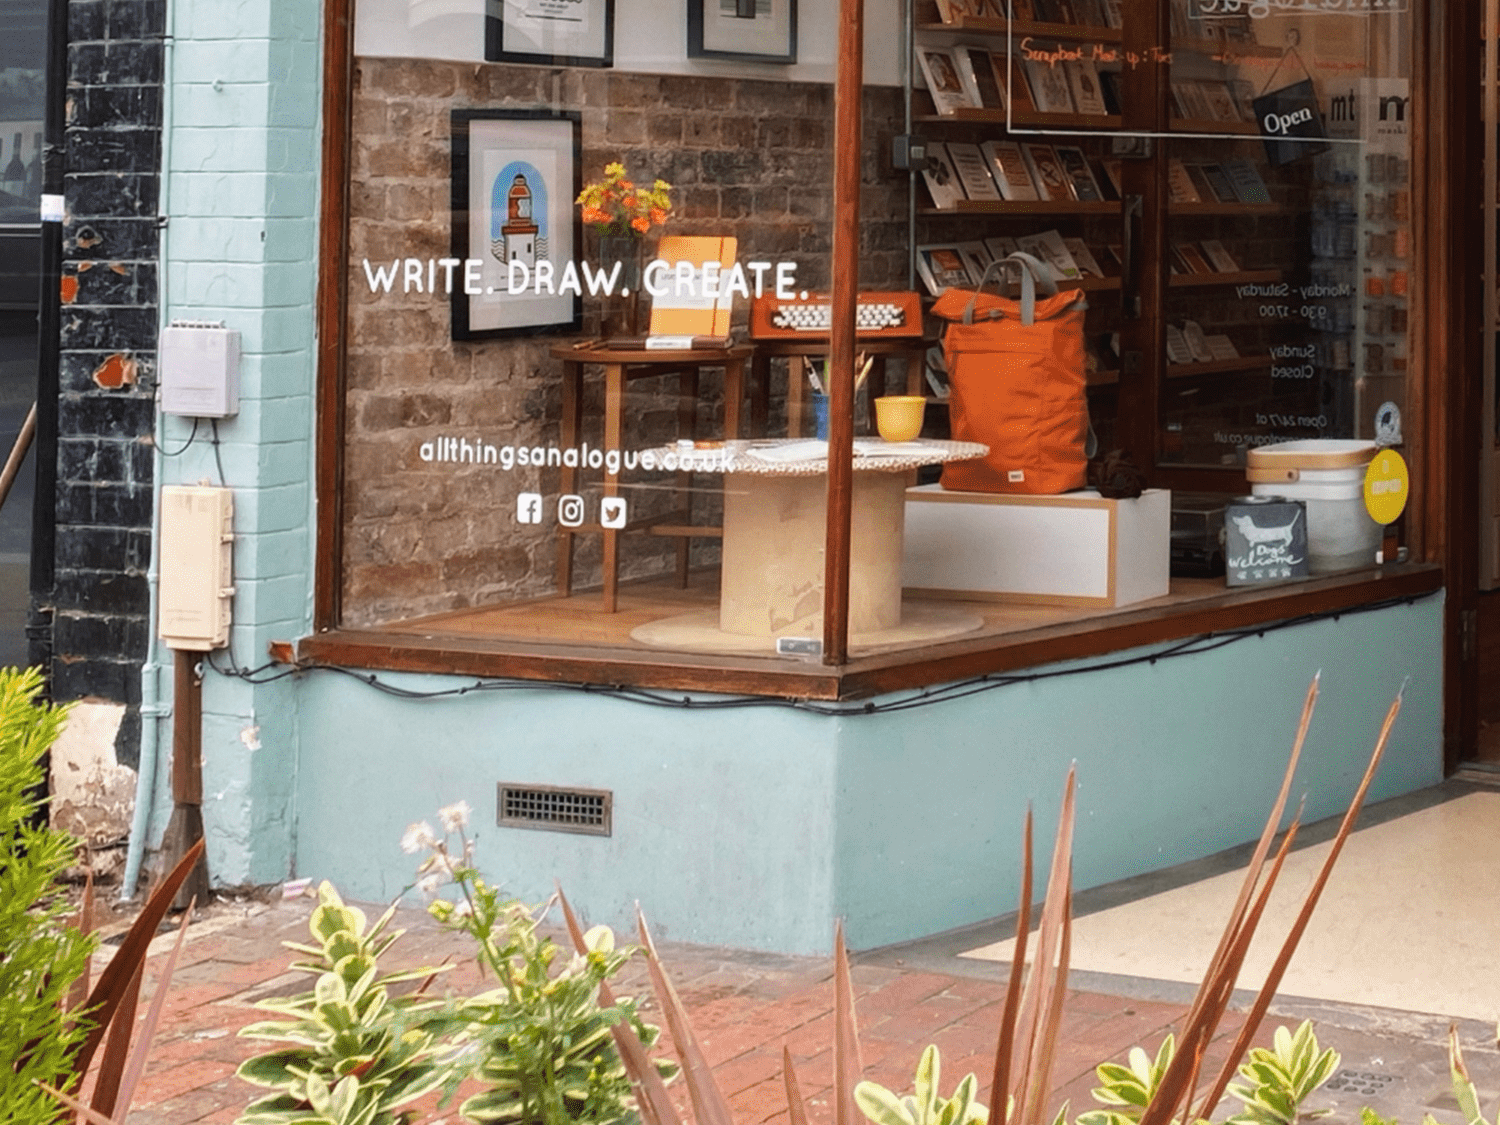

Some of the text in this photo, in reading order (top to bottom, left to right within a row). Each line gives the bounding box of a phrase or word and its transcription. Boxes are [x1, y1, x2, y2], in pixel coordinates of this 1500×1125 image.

[1263, 107, 1313, 135] Open
[362, 257, 810, 301] WRITE. DRAW. CREATE.
[419, 436, 736, 475] allthingsanalogue.co.uk
[1256, 544, 1286, 559] Dogs
